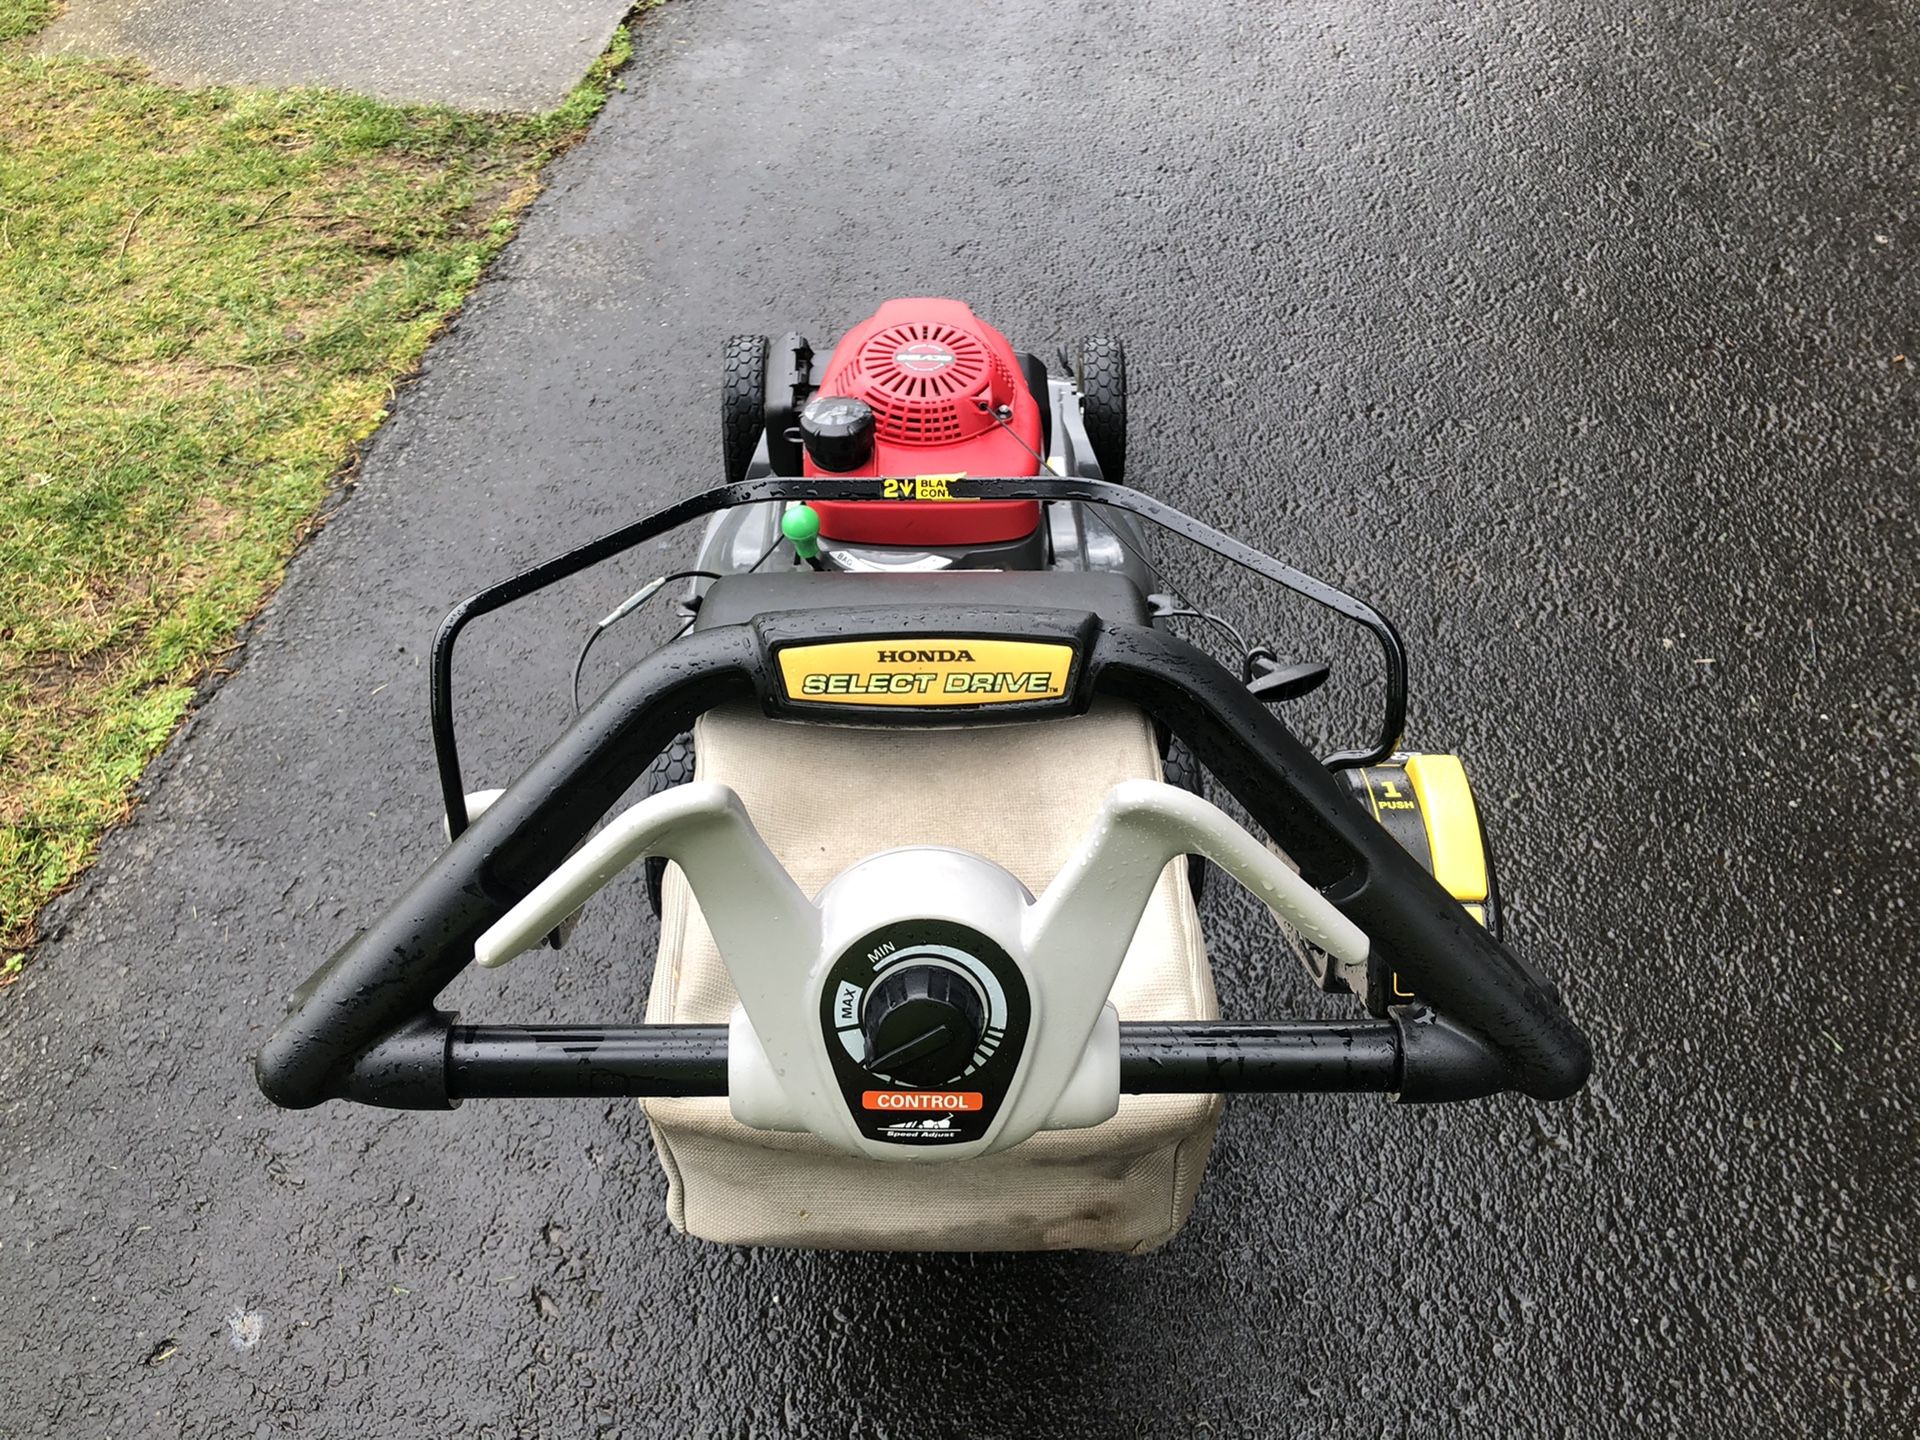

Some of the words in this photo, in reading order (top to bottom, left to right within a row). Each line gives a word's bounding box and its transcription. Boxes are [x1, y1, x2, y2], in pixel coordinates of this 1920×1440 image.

[877, 650, 976, 663] HONDA
[802, 673, 937, 695] SELECT
[944, 671, 1052, 693] DRIVE
[1381, 781, 1402, 798] 1
[1378, 801, 1415, 810] PUSH
[866, 941, 896, 964] MIN
[841, 988, 857, 1019] MAX
[877, 1094, 969, 1109] CONTROL
